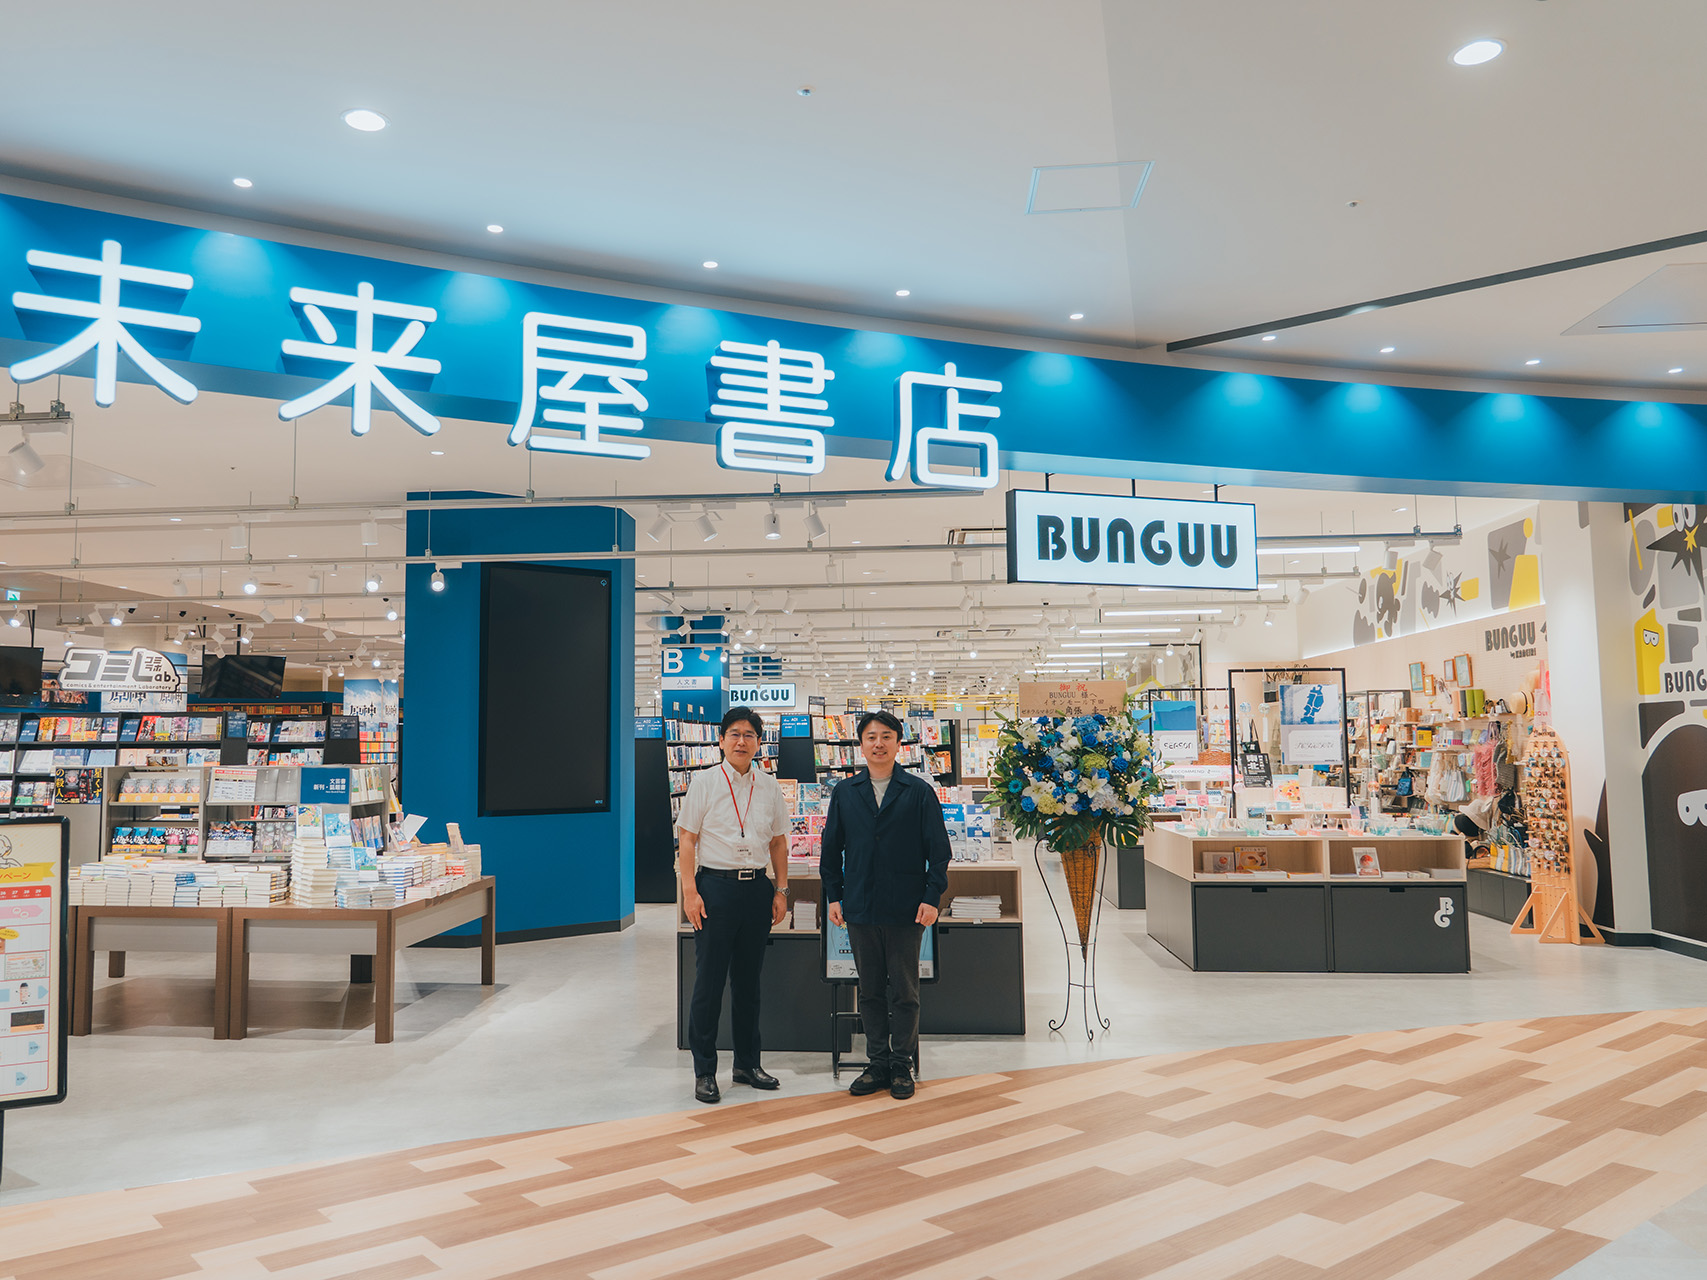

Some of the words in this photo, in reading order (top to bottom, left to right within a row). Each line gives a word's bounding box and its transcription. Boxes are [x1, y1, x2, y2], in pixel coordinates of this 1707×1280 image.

[9, 239, 1002, 490] 未来屋書店
[1036, 514, 1238, 569] BUNGUU
[1485, 621, 1536, 652] BUNGUU
[664, 649, 684, 673] B
[730, 689, 790, 702] BUNGUU
[1049, 691, 1077, 699] BUNGUU
